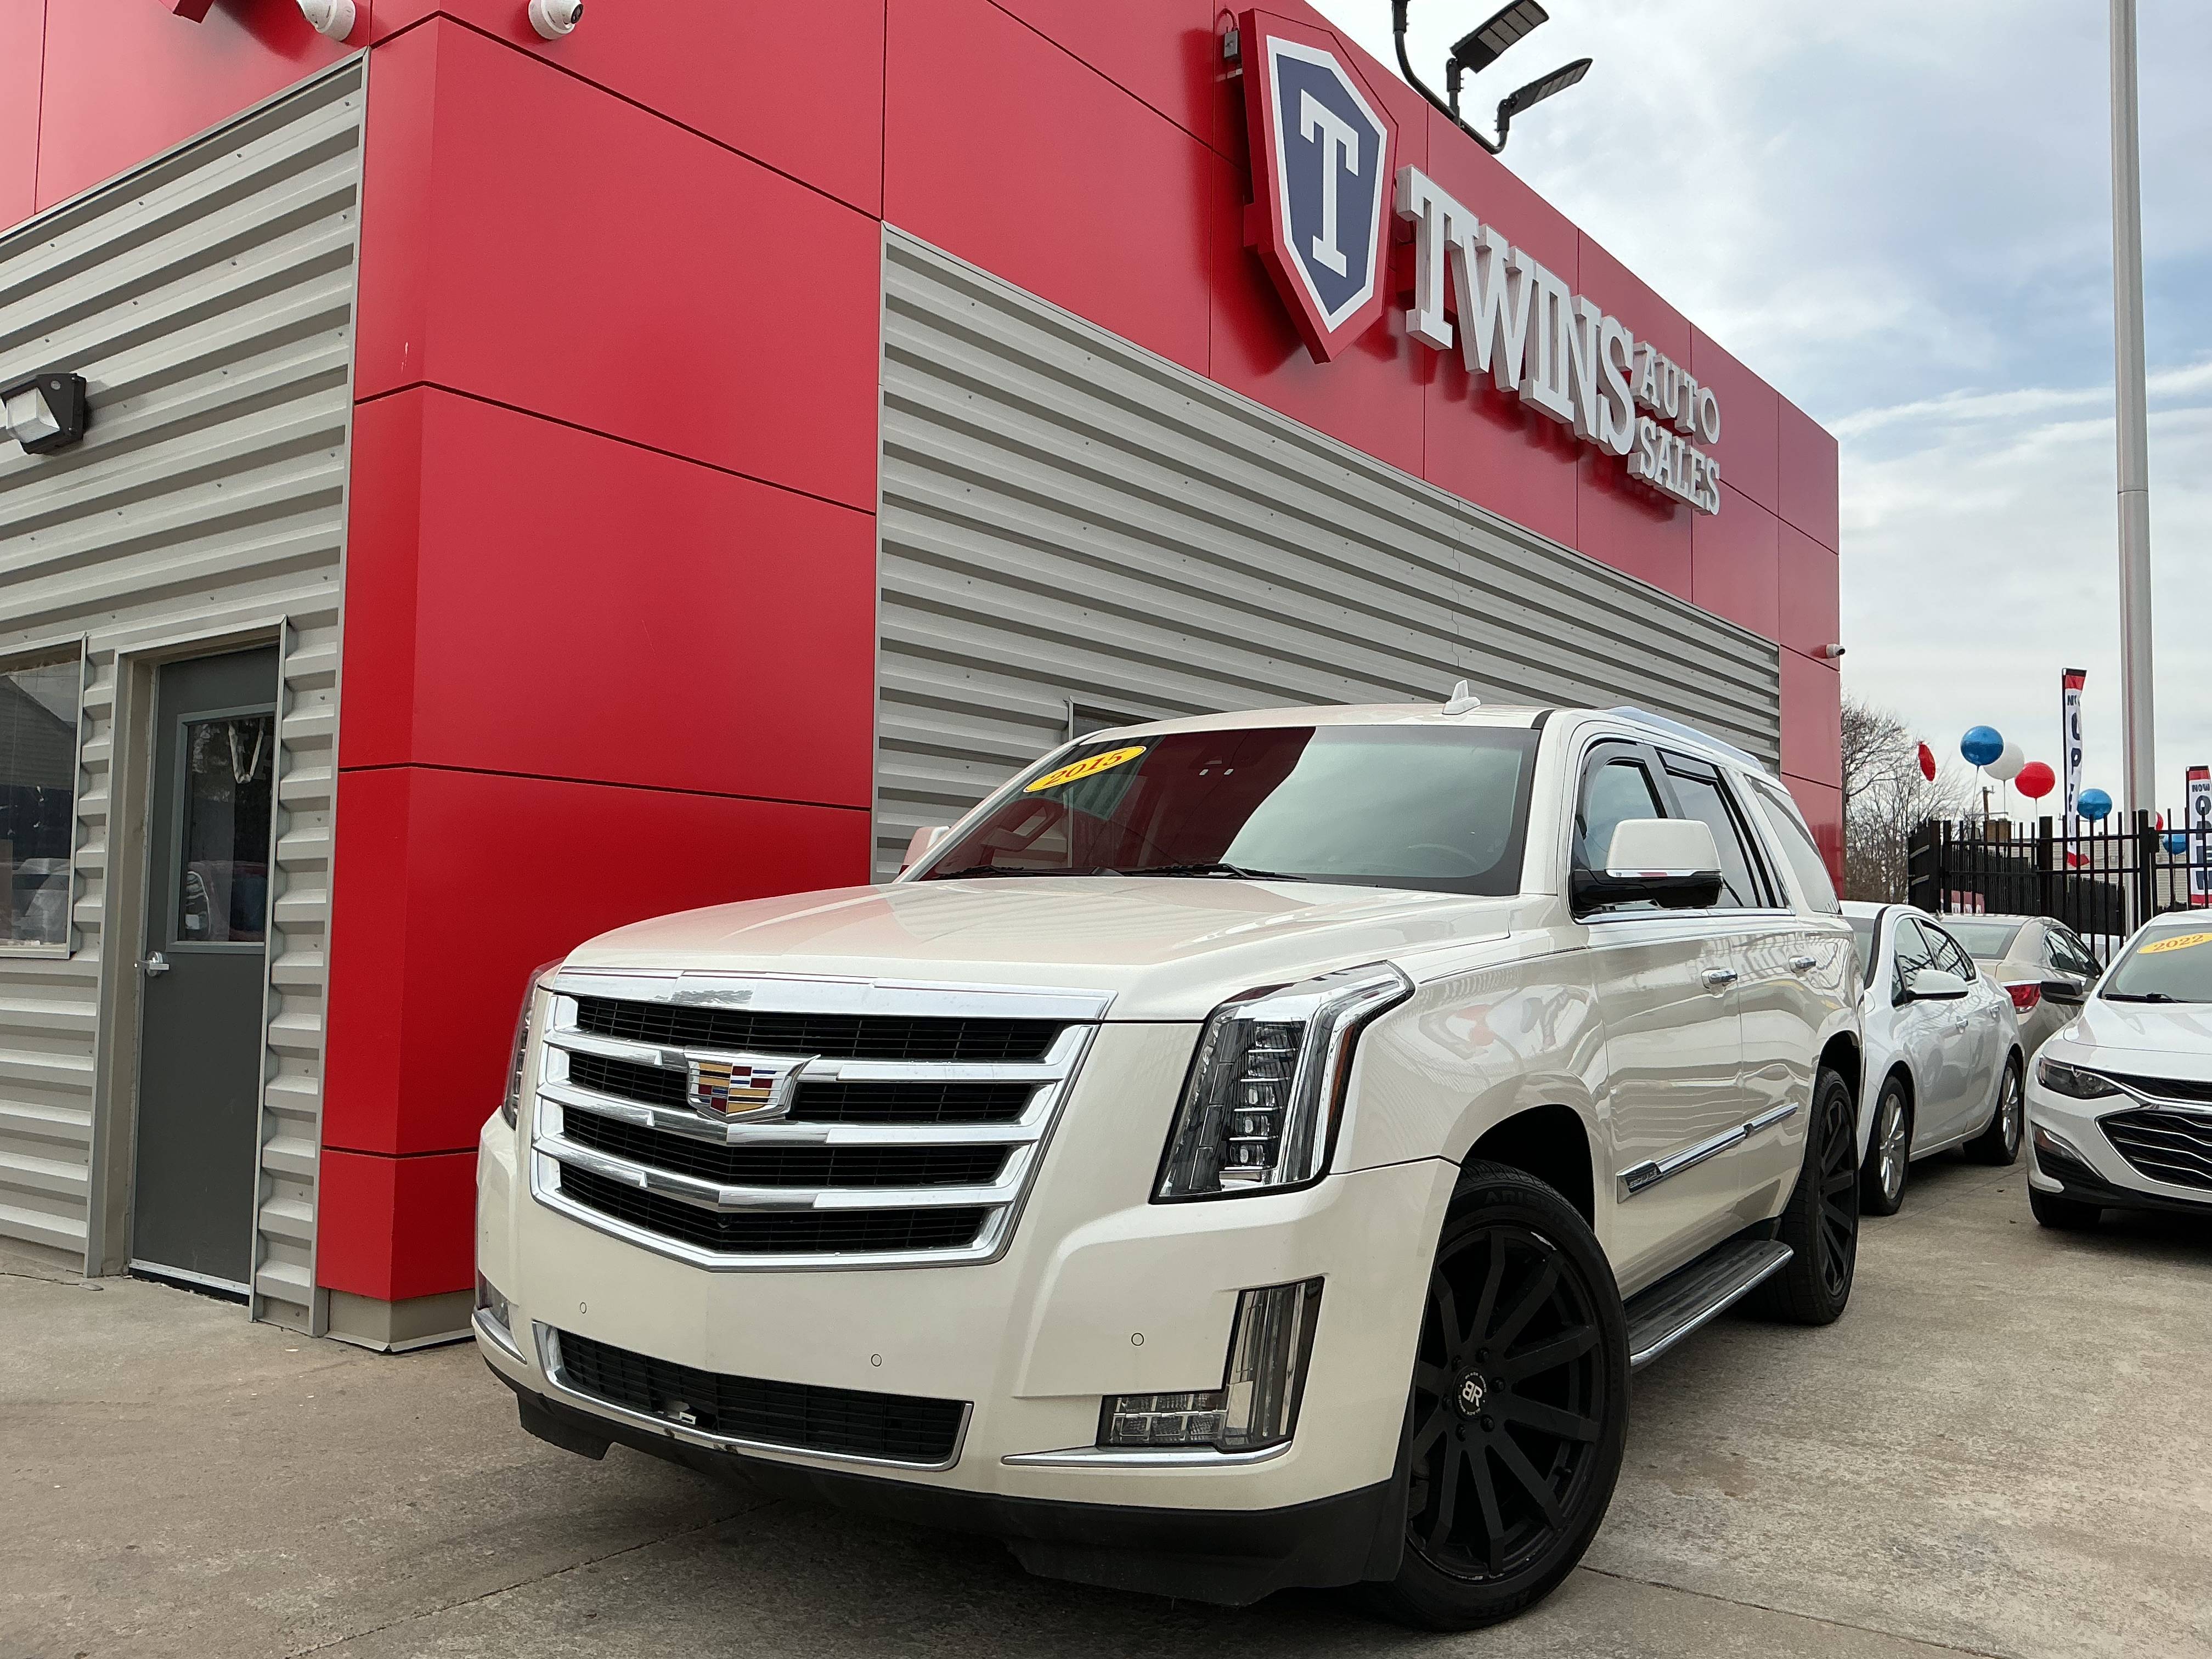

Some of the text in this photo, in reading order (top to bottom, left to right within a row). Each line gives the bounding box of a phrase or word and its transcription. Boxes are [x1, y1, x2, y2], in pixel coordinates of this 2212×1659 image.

[1300, 88, 1359, 278] T
[1397, 164, 1635, 456] TWINS
[1632, 340, 1720, 445] AUTO
[1628, 416, 1720, 516] SALES
[1043, 751, 1127, 786] 2015
[2192, 783, 2210, 793] NOW
[2153, 934, 2204, 951] 2022
